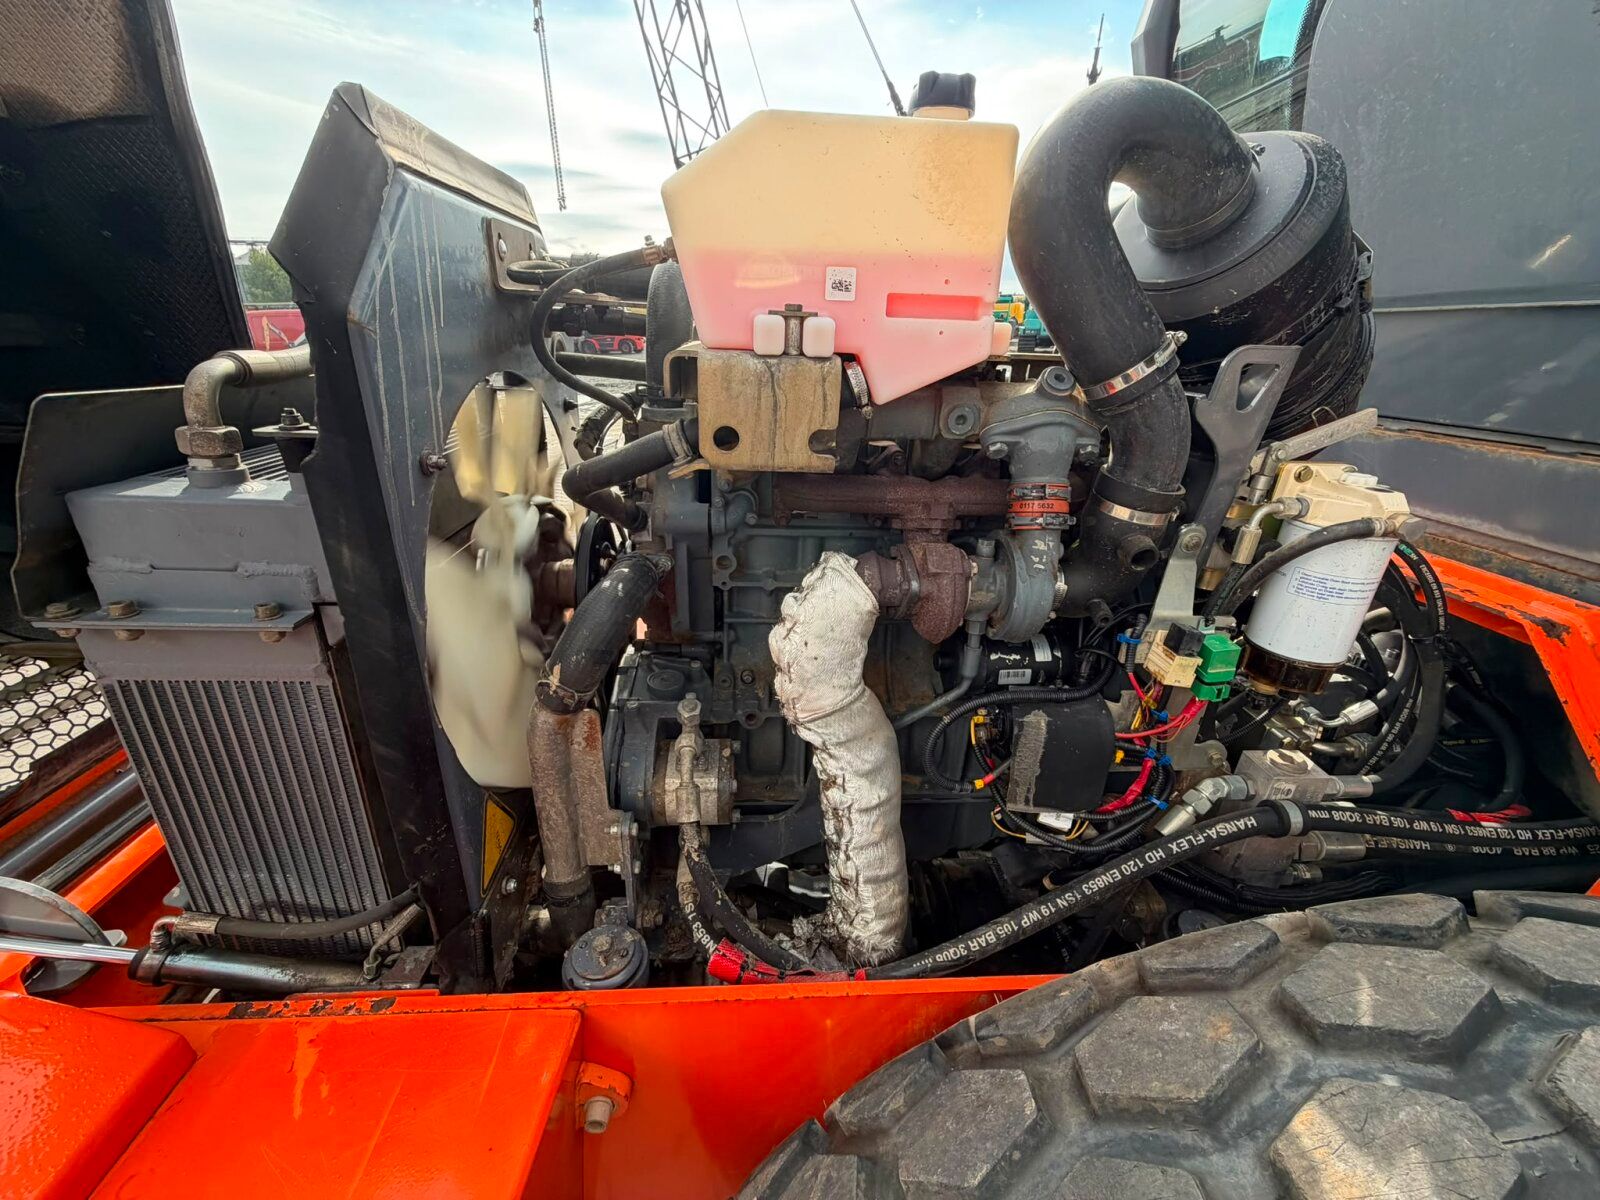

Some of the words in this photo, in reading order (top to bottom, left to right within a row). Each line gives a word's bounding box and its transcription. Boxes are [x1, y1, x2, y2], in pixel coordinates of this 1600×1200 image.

[1391, 721, 1403, 735] BAR
[1332, 810, 1363, 824] 3Q08
[1363, 813, 1390, 827] BAR
[1391, 816, 1411, 829] 105
[1413, 820, 1432, 833] WP
[1432, 821, 1444, 833] 19
[1444, 822, 1465, 836] 1SN
[1466, 825, 1498, 839] EN853
[1499, 827, 1516, 840] 120
[1168, 816, 1258, 855] HANSA-FLEX
[1517, 828, 1533, 841] HD
[1145, 848, 1166, 864] HD
[1123, 857, 1145, 876] 120
[1082, 869, 1122, 896] EN853
[1056, 889, 1082, 910] 1SN
[1040, 902, 1056, 917] 19
[1021, 912, 1042, 928] WP
[997, 922, 1019, 939] 105
[968, 931, 997, 951] BAR
